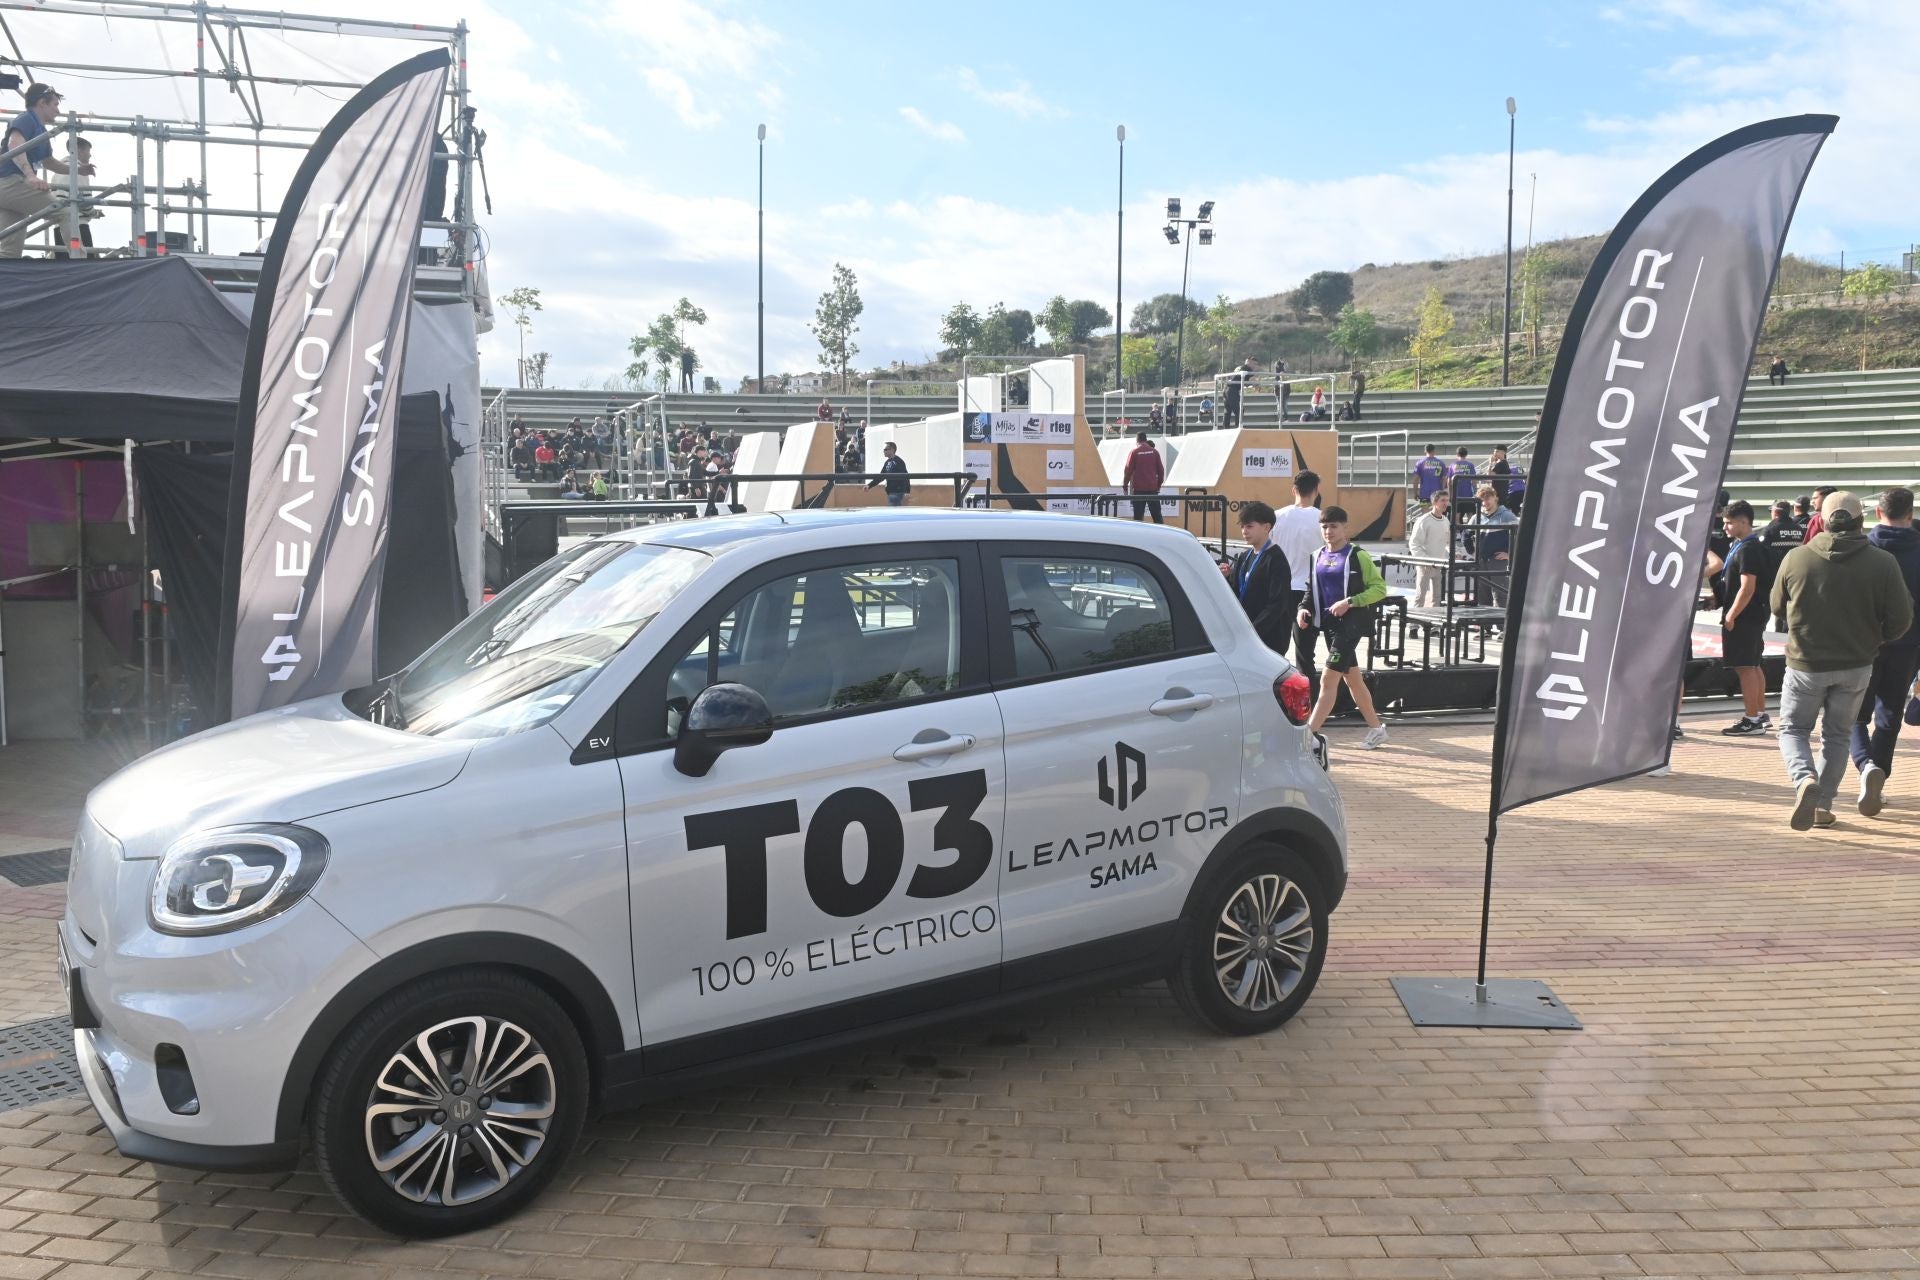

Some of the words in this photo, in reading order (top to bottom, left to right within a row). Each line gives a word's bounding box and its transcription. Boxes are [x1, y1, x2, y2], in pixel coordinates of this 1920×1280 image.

[272, 200, 349, 621] LEAPMOTOR
[342, 331, 389, 527] SAMA
[1049, 420, 1072, 434] rfeg
[1550, 248, 1674, 663] LEAPMOTOR
[1245, 454, 1265, 467] rfeg
[1645, 395, 1720, 590] SAMA
[589, 736, 610, 749] EV
[683, 768, 994, 941] T03
[1008, 806, 1229, 873] LEAPMOTOR
[1090, 852, 1158, 889] SAMA
[691, 955, 756, 996] 100
[764, 947, 795, 981] %
[806, 904, 996, 972] ELÉCTRICO
